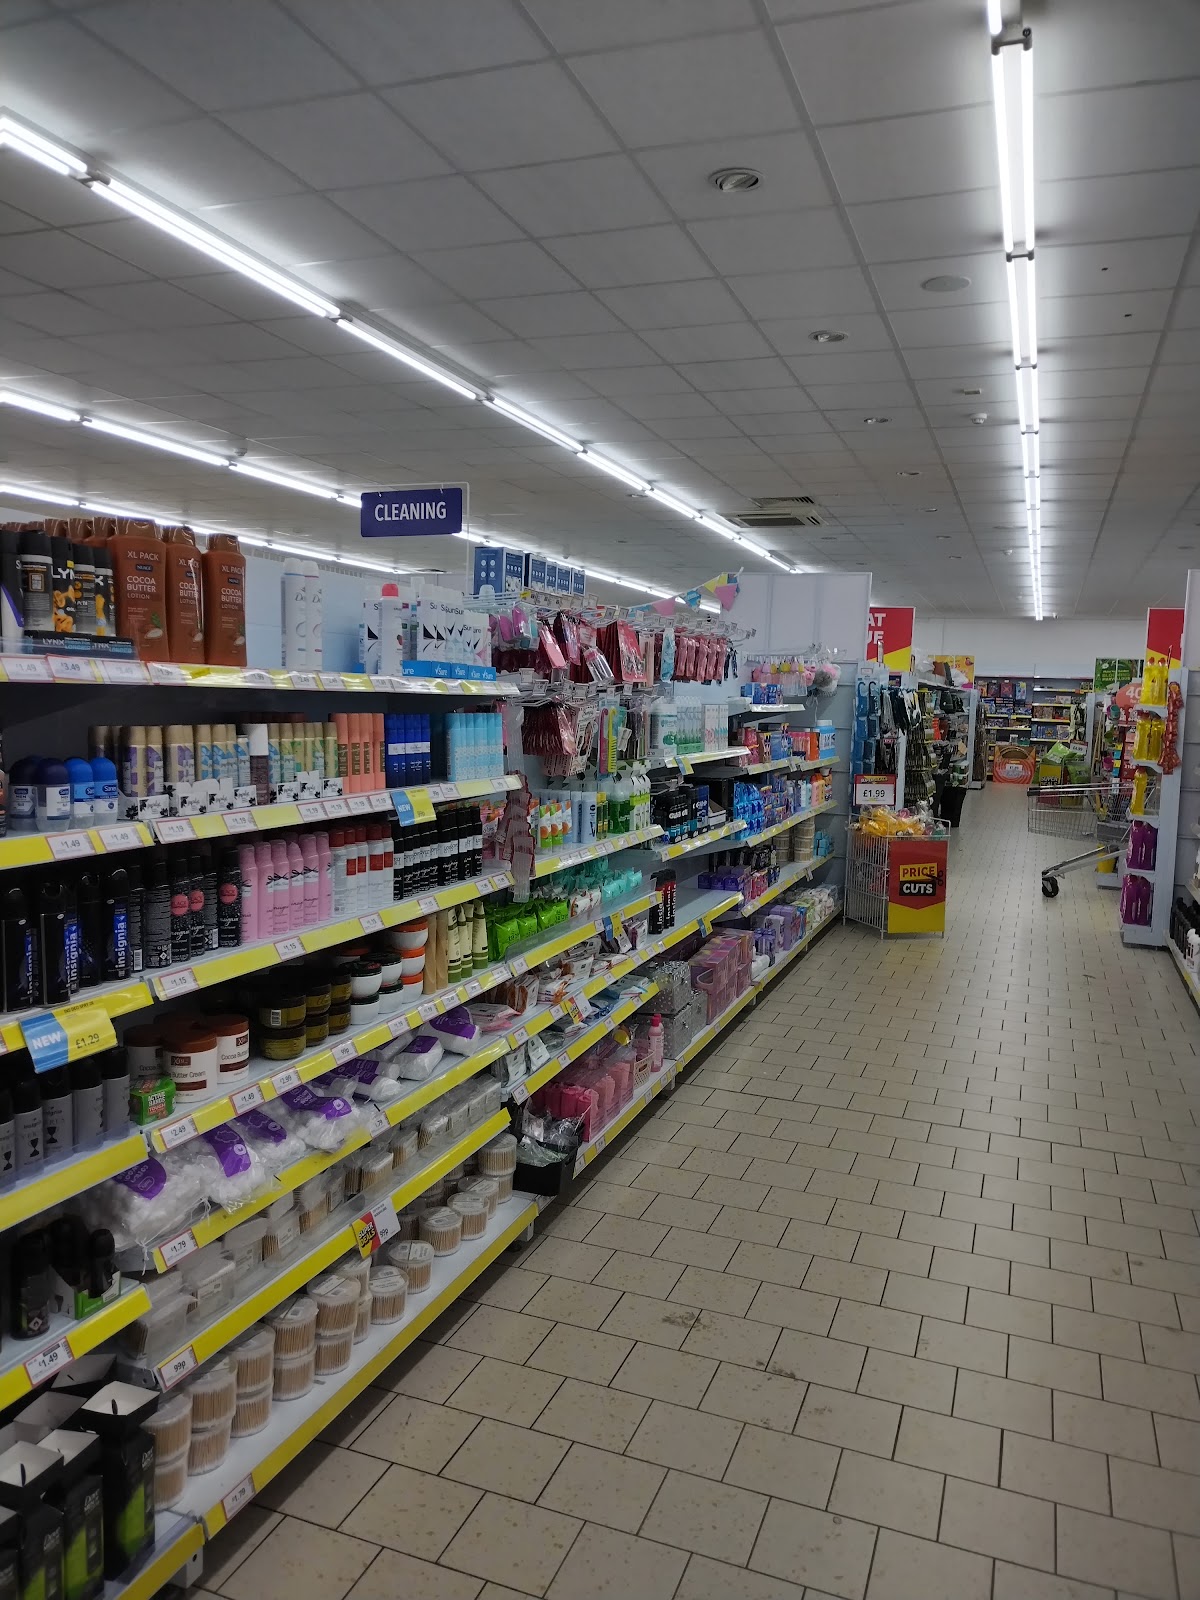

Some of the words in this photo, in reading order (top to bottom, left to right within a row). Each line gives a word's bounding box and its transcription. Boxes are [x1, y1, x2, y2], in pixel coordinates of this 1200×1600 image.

[374, 501, 447, 522] CLEANING
[127, 550, 138, 559] XL
[139, 551, 159, 561] PACK
[179, 558, 187, 566] XL
[221, 565, 230, 573] XL
[126, 575, 156, 585] COCOA
[126, 584, 156, 593] BUTTER
[179, 581, 198, 591] COCOA
[127, 592, 150, 600] LOTION
[221, 587, 241, 596] COCOA
[221, 594, 242, 604] BUTTER
[42, 638, 65, 646] LYNX
[60, 662, 81, 672] £3.49
[862, 789, 886, 798] £1.99
[305, 807, 319, 815] £1.19
[398, 803, 412, 813] NEW
[232, 817, 247, 826] £1.19
[168, 825, 184, 834] £1.19
[110, 833, 129, 842] £1.49
[60, 839, 81, 849] £1.49
[902, 866, 936, 878] PRICE
[902, 883, 934, 894] CUTS
[115, 921, 128, 969] insignia
[283, 941, 297, 951] £1.15
[68, 931, 79, 981] insignia
[171, 976, 187, 987] £1.15
[31, 1030, 62, 1050] NEW
[75, 1032, 100, 1050] £1.29
[340, 1047, 350, 1056] 99p
[221, 1053, 237, 1061] Cocoa
[139, 1064, 157, 1072] Cocoa
[172, 1071, 188, 1079] Butter
[188, 1070, 206, 1079] Cream
[279, 1074, 292, 1085] £2.99
[240, 1092, 255, 1103] £1.49
[170, 1124, 186, 1137] £2.49
[358, 1222, 374, 1239] SUPER
[360, 1230, 376, 1249] DEALS
[170, 1240, 187, 1254] £1.79
[38, 1352, 59, 1369] £1.49
[173, 1360, 186, 1373] 99p
